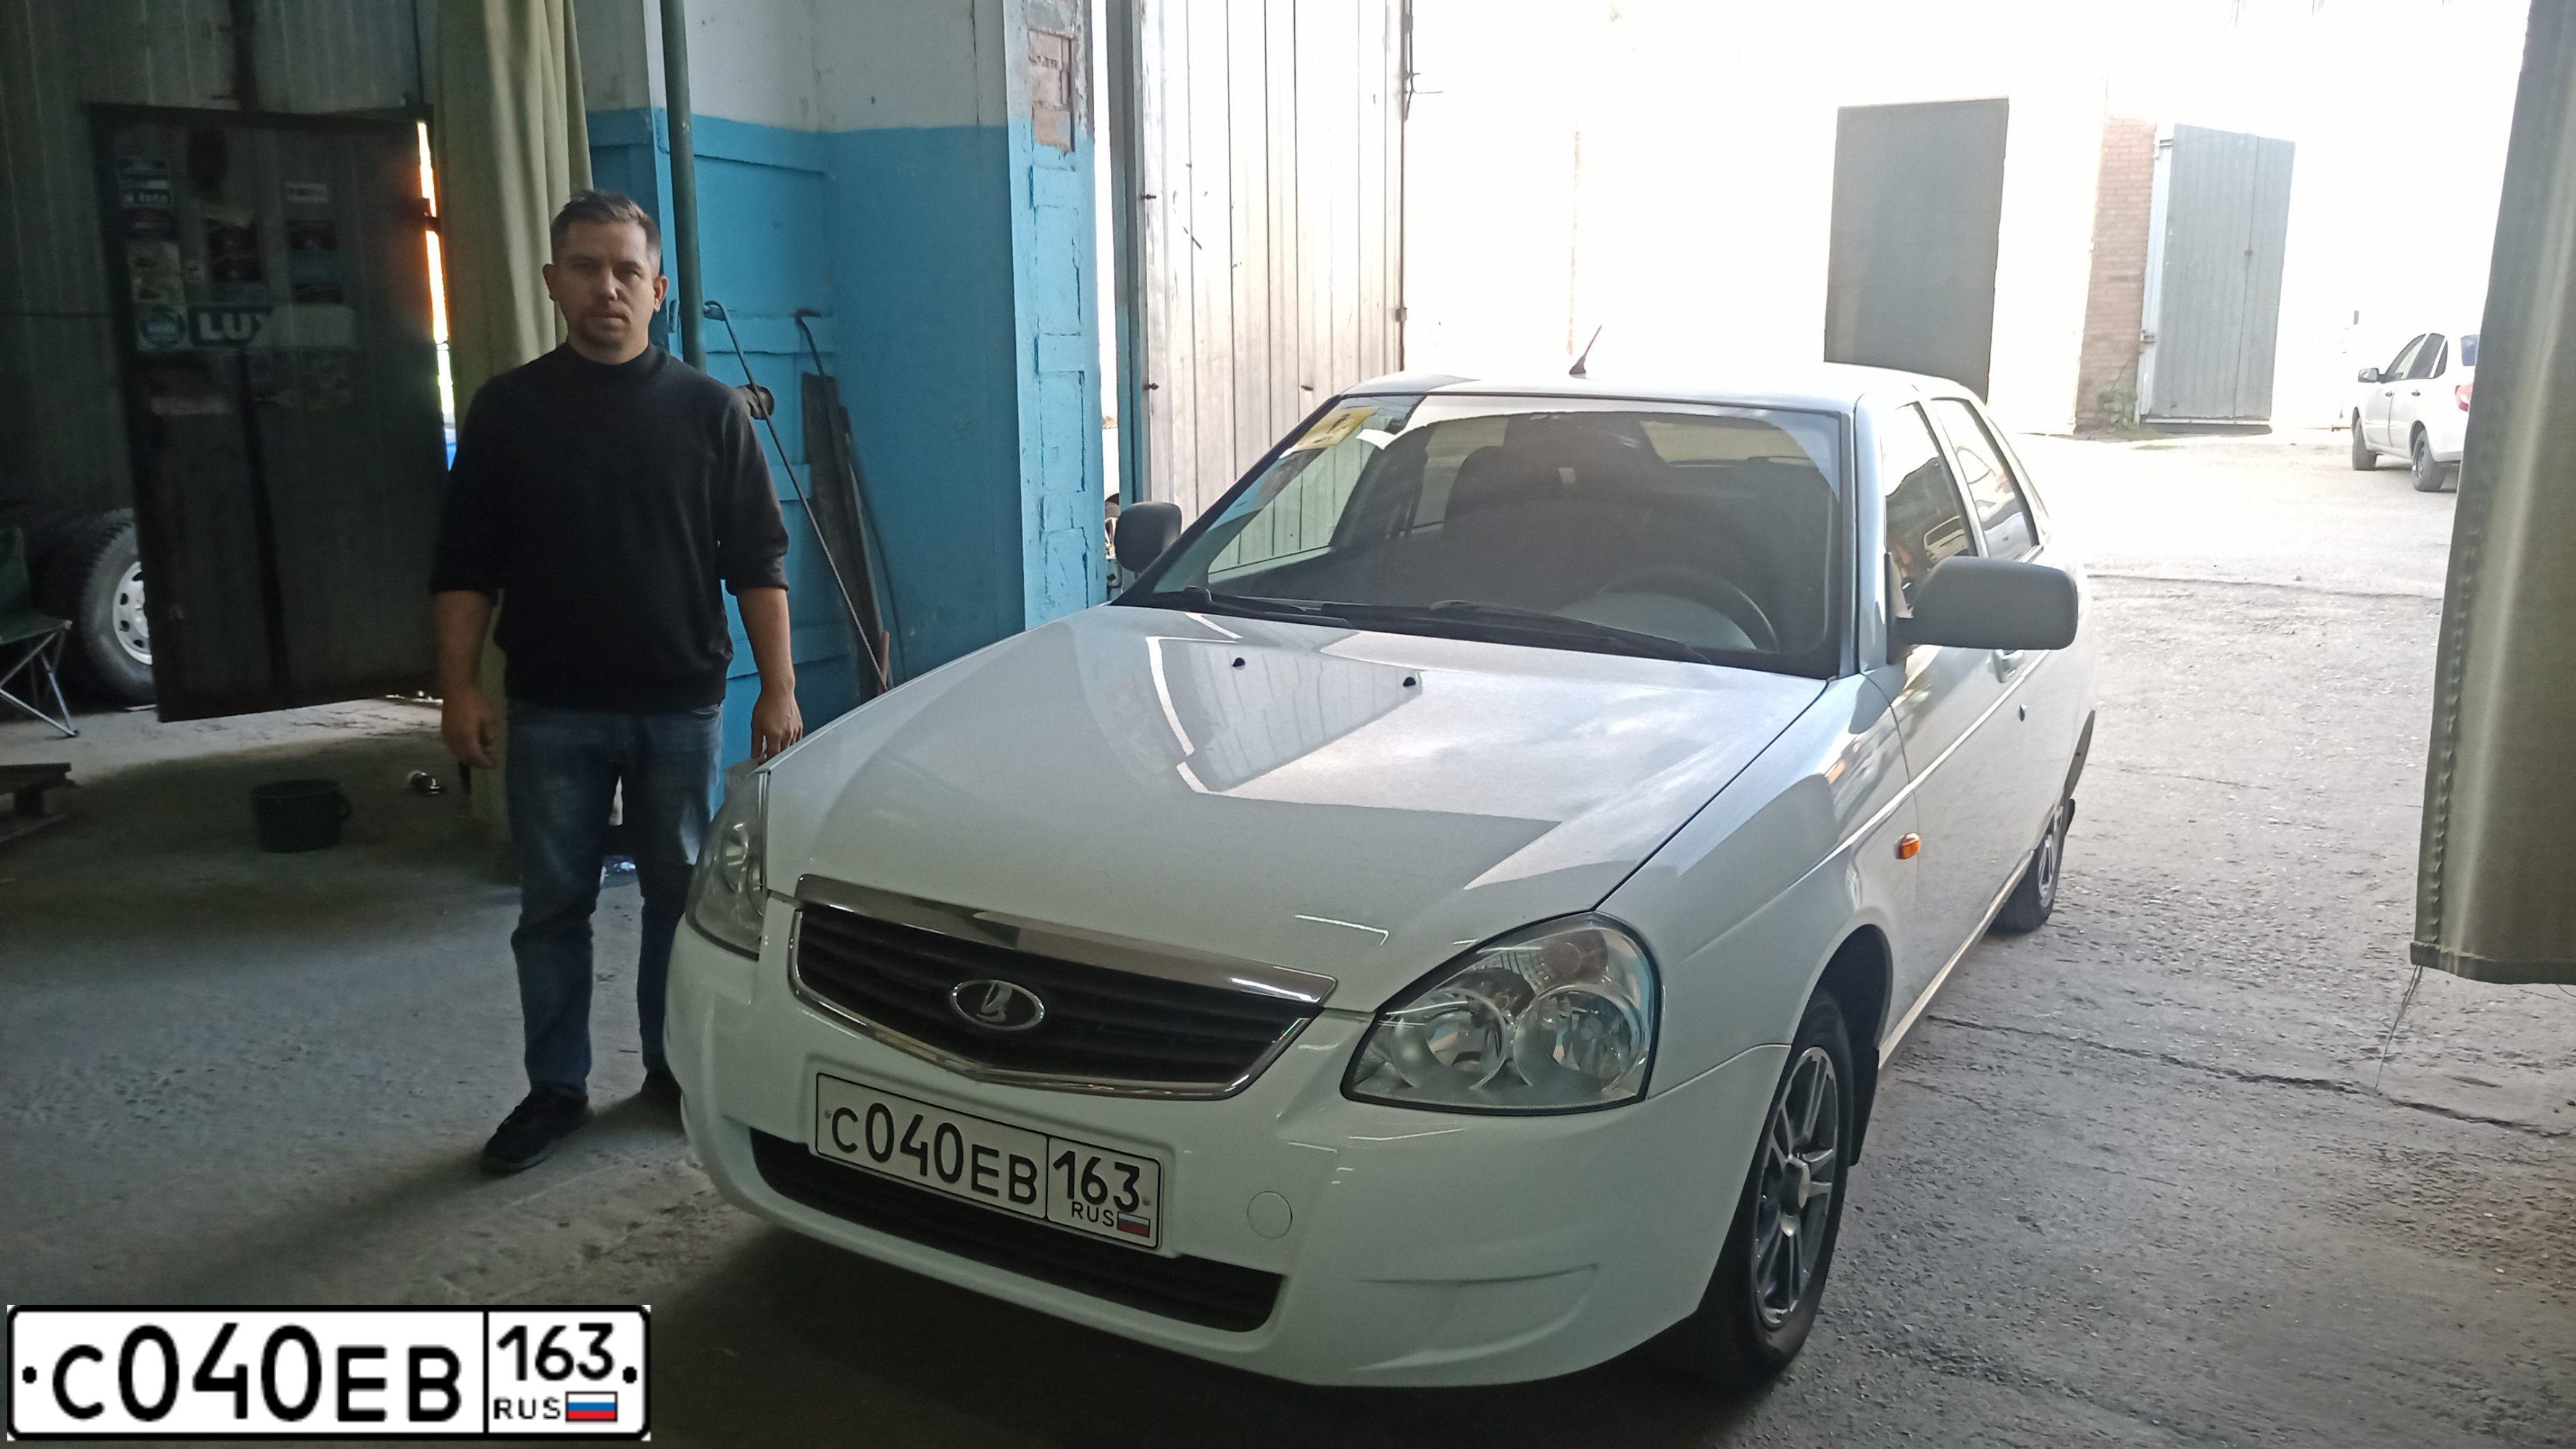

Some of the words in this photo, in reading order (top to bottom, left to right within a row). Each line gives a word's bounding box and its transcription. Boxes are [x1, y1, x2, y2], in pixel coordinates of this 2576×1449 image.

[831, 1102, 1038, 1206] С040ЕВ
[1052, 1150, 1141, 1214] 163
[1071, 1200, 1115, 1227] RUS
